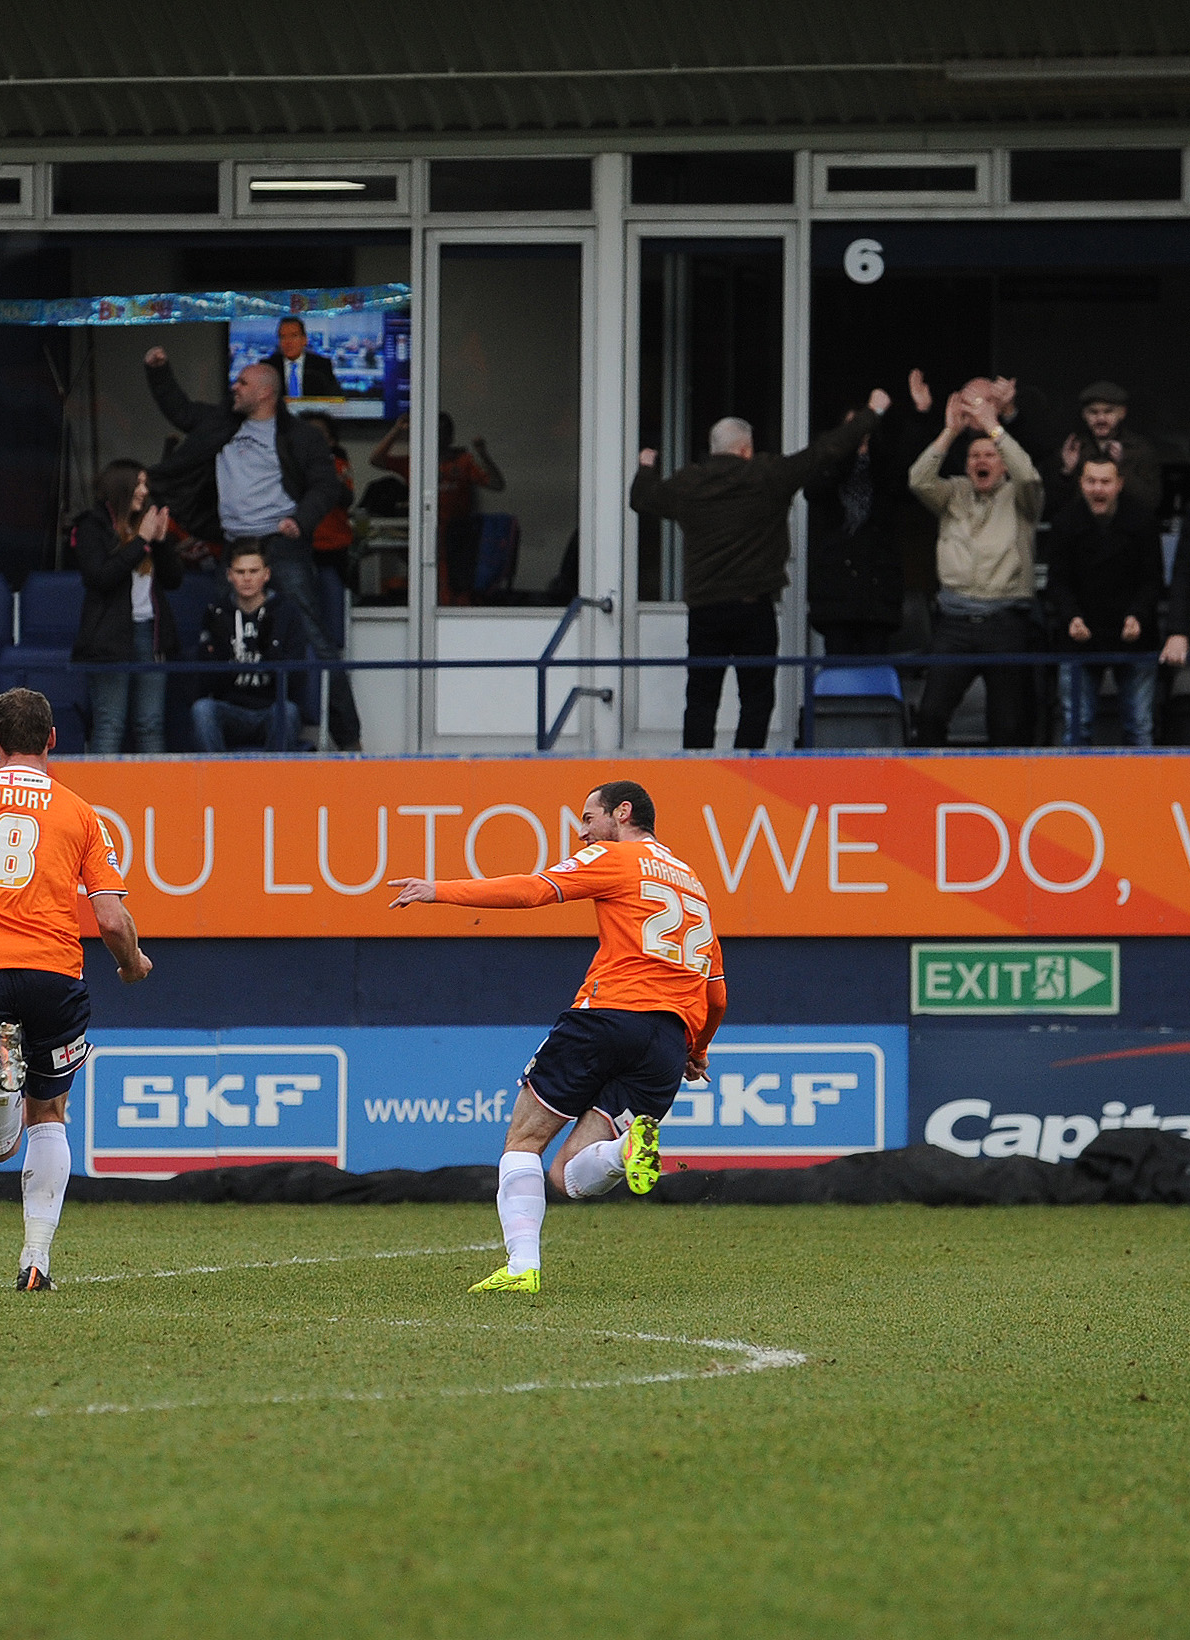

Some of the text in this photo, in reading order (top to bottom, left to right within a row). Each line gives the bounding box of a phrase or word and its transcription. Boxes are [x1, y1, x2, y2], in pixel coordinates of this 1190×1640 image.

[843, 237, 885, 284] 6
[701, 803, 889, 894] WE
[936, 800, 1131, 906] DO,
[639, 880, 714, 978] 22
[925, 962, 1031, 1000] EXIT
[117, 1074, 321, 1128] SKF
